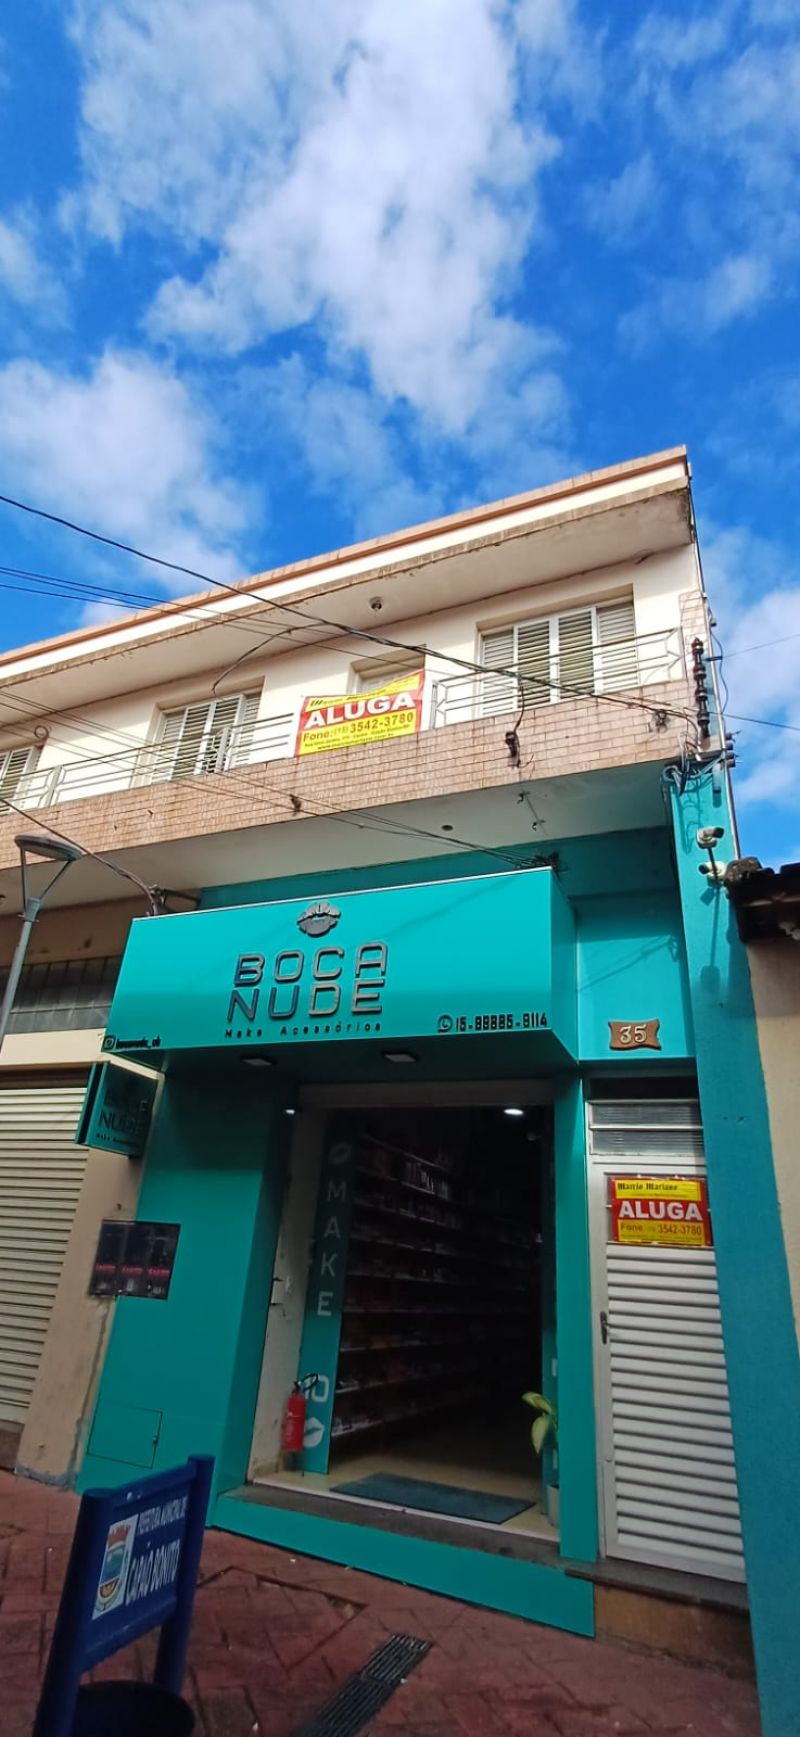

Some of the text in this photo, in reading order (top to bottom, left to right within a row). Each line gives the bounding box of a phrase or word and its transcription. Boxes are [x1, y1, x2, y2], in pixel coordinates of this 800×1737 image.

[303, 692, 417, 730] ALUGA
[350, 711, 414, 734] 3542-3780
[233, 941, 388, 987] BOCA
[227, 978, 385, 1025] NUDE
[225, 1028, 263, 1039] Make
[620, 1024, 648, 1044] 35
[619, 1200, 704, 1221] ALUGA
[317, 1180, 348, 1317] MAKE
